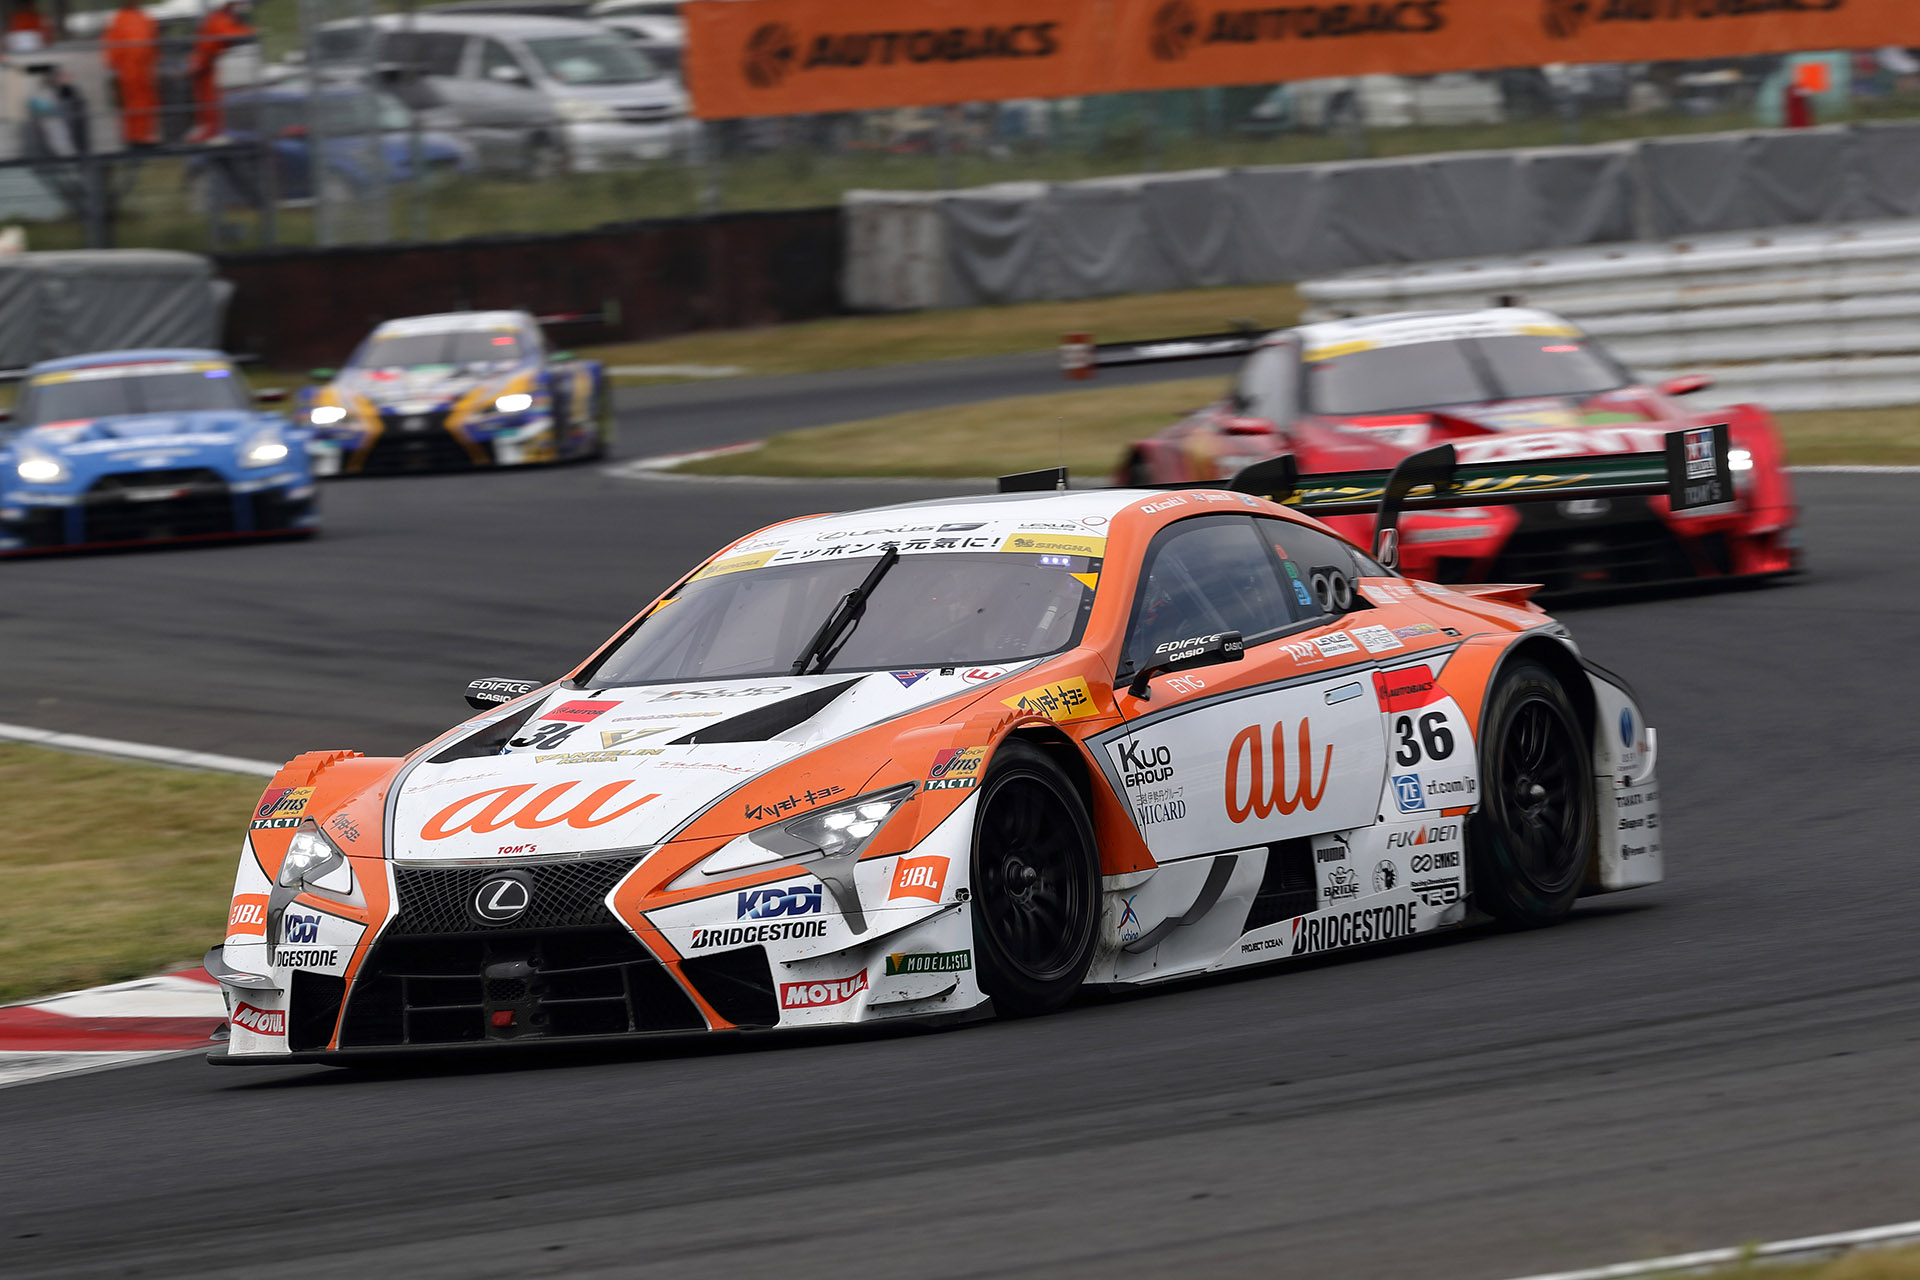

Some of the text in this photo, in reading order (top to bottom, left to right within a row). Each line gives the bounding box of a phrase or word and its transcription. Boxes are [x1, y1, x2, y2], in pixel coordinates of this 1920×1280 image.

[804, 22, 1060, 69] AUTOBACS
[1035, 542, 1093, 553] SINGHA
[1155, 633, 1222, 654] EDIFICE
[1224, 641, 1244, 652] CASIO
[1169, 647, 1205, 662] CASIO
[468, 680, 532, 694] EDIFICE
[476, 692, 513, 703] CASIO
[1388, 682, 1434, 697] AUTOBACS
[509, 722, 586, 751] 36
[1394, 711, 1455, 767] 36
[534, 749, 665, 764] VANTELIN
[1125, 766, 1174, 788] GROUP
[1225, 716, 1334, 824] au
[926, 778, 976, 791] TACTI
[419, 779, 663, 841] au
[1137, 799, 1187, 827] MICARD
[254, 818, 300, 829] TACTI
[497, 844, 537, 854] TOM'S
[1317, 846, 1346, 863] PUMA
[1434, 851, 1460, 869] ENKEI
[901, 863, 938, 889] JBL
[1323, 882, 1360, 897] BRIDE
[737, 883, 823, 921] KDDI
[285, 914, 322, 944] KDDI
[690, 920, 827, 949] BRIDGESTONE
[1291, 901, 1418, 956] BRIDGESTONE
[1241, 937, 1284, 954] PROJECT OCEAN
[907, 951, 969, 972] MODELLISTA
[784, 972, 866, 1006] MOTUL
[234, 1007, 284, 1033] MOTUL
